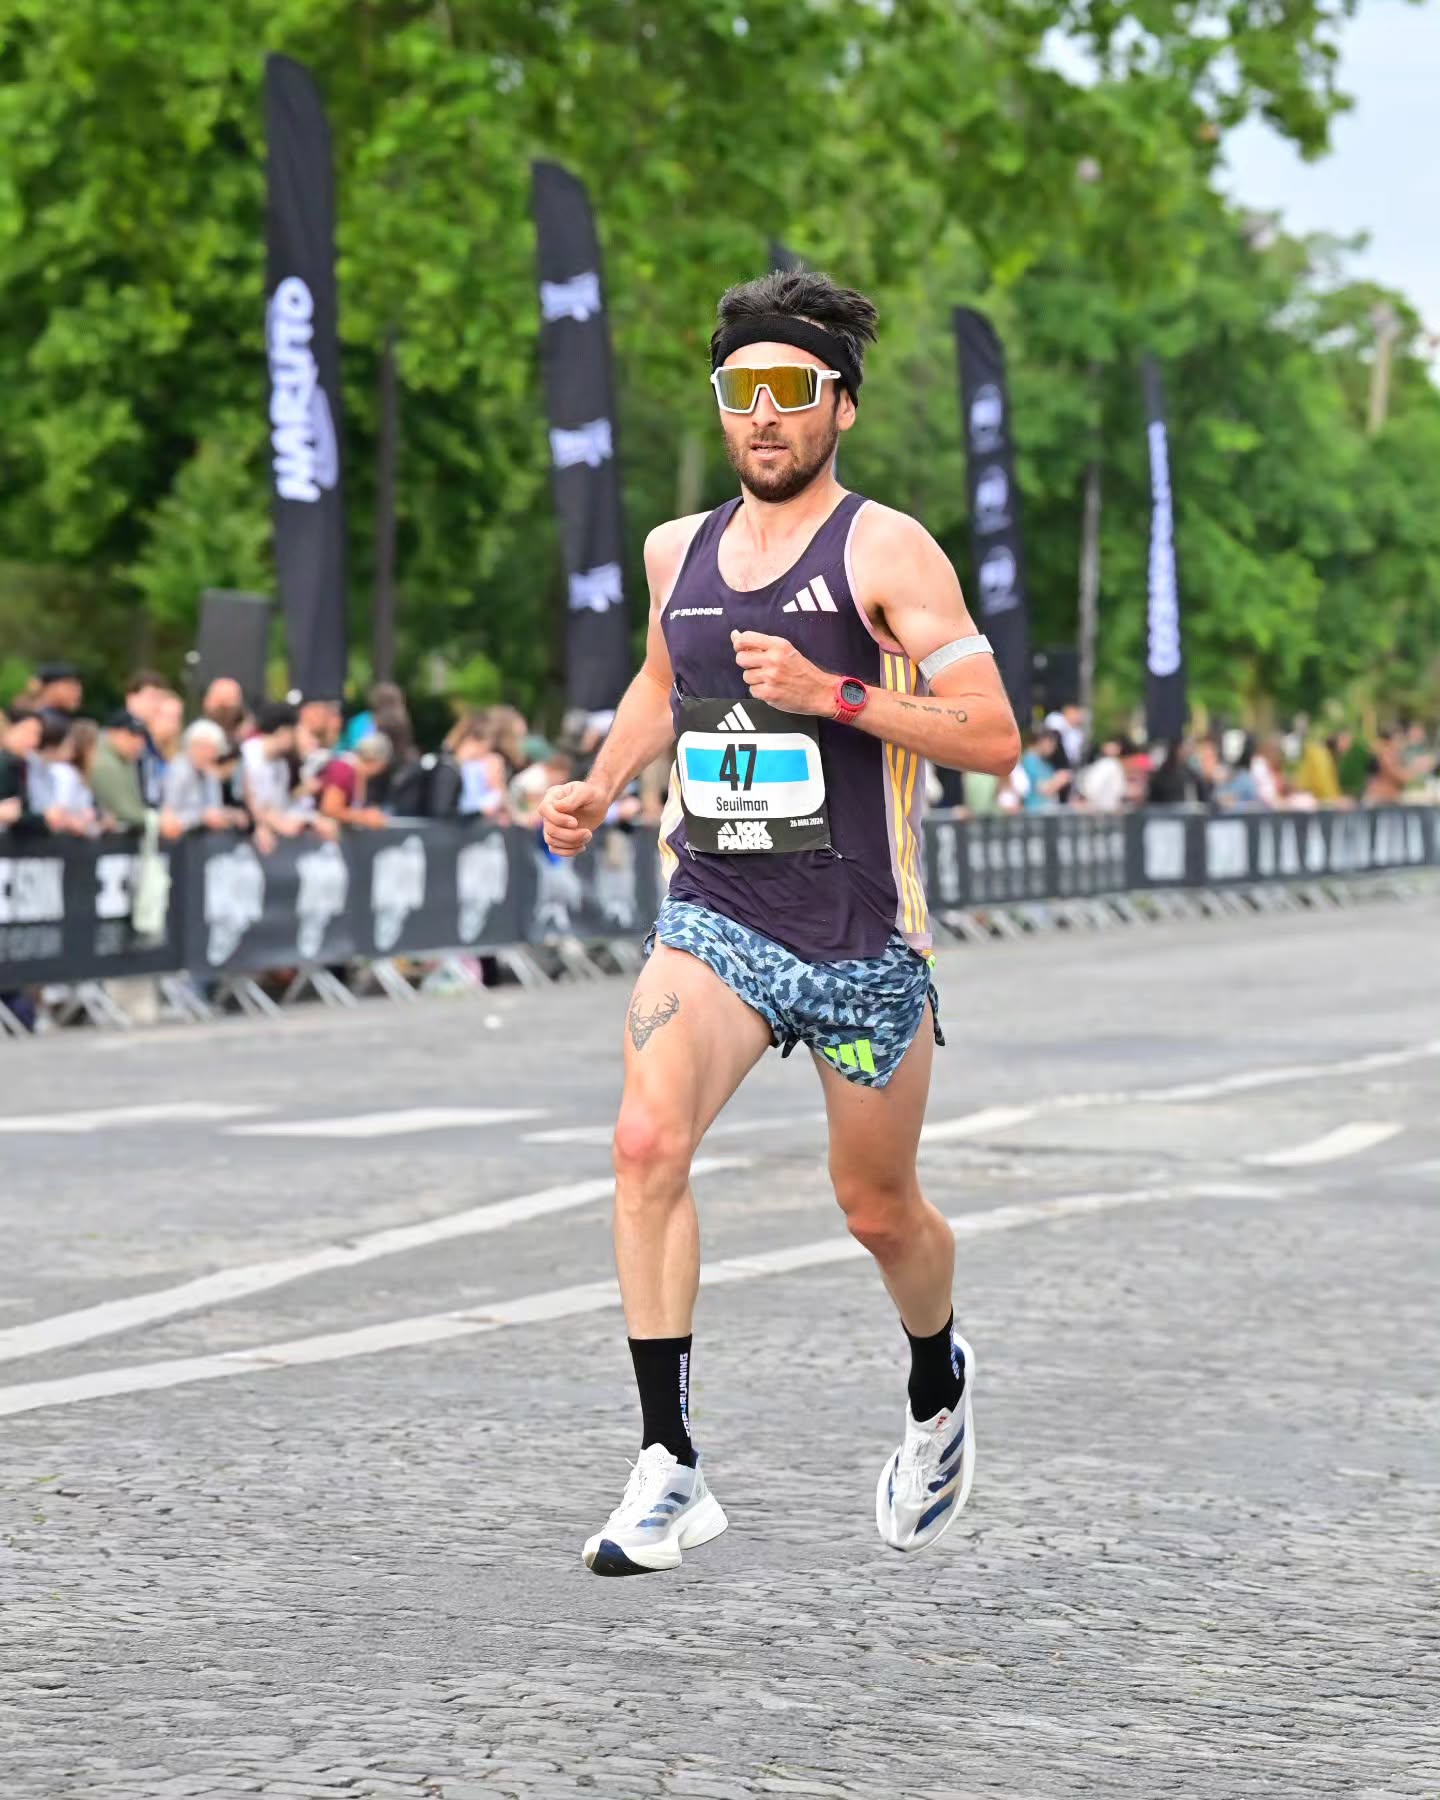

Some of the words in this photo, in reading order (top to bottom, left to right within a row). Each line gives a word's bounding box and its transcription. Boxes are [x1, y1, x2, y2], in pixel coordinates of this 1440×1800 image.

[718, 743, 757, 792] 47
[716, 796, 769, 812] Seuilman
[717, 833, 774, 850] PARIS
